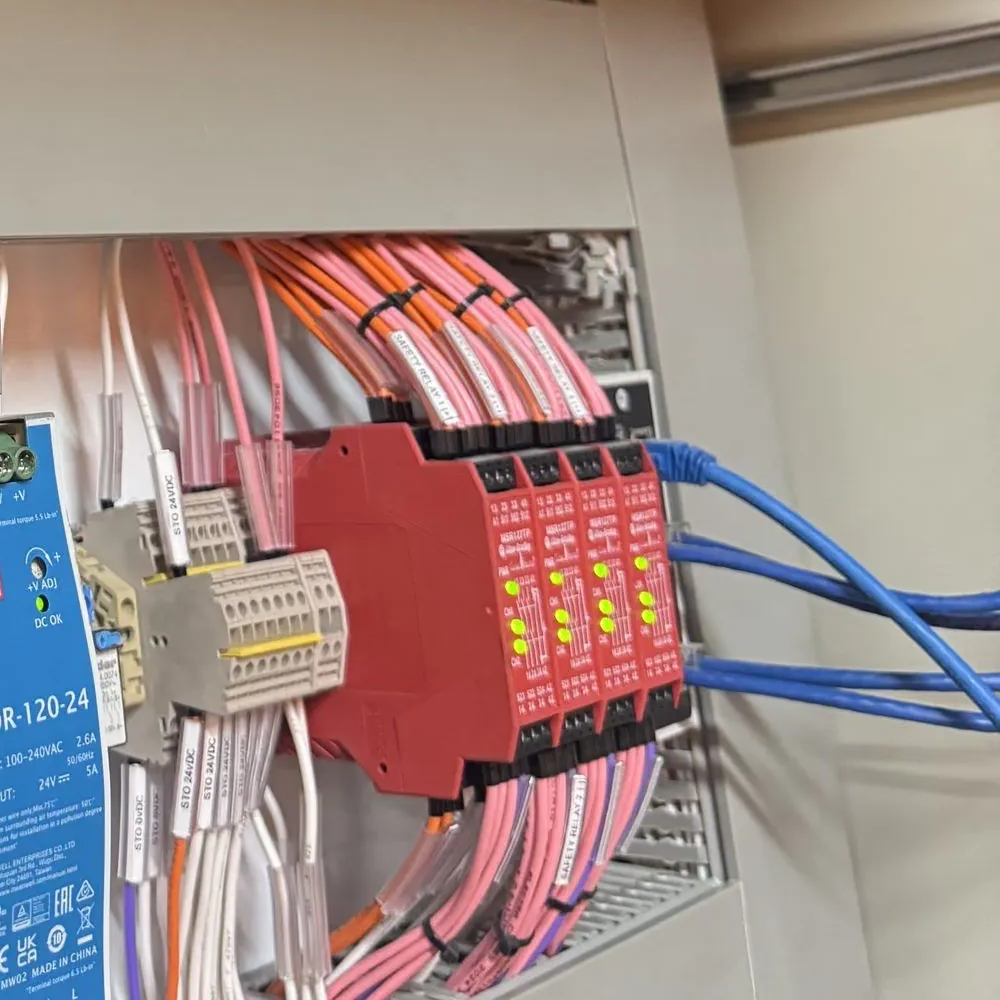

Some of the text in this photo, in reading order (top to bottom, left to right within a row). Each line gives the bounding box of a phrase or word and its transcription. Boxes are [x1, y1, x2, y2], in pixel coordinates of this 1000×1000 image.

[34, 613, 63, 629] DC OK
[75, 731, 97, 748] 2.6A
[86, 762, 99, 777] 5A
[31, 960, 57, 978] MADE
[59, 955, 69, 968] IN
[70, 944, 98, 963] CHINA
